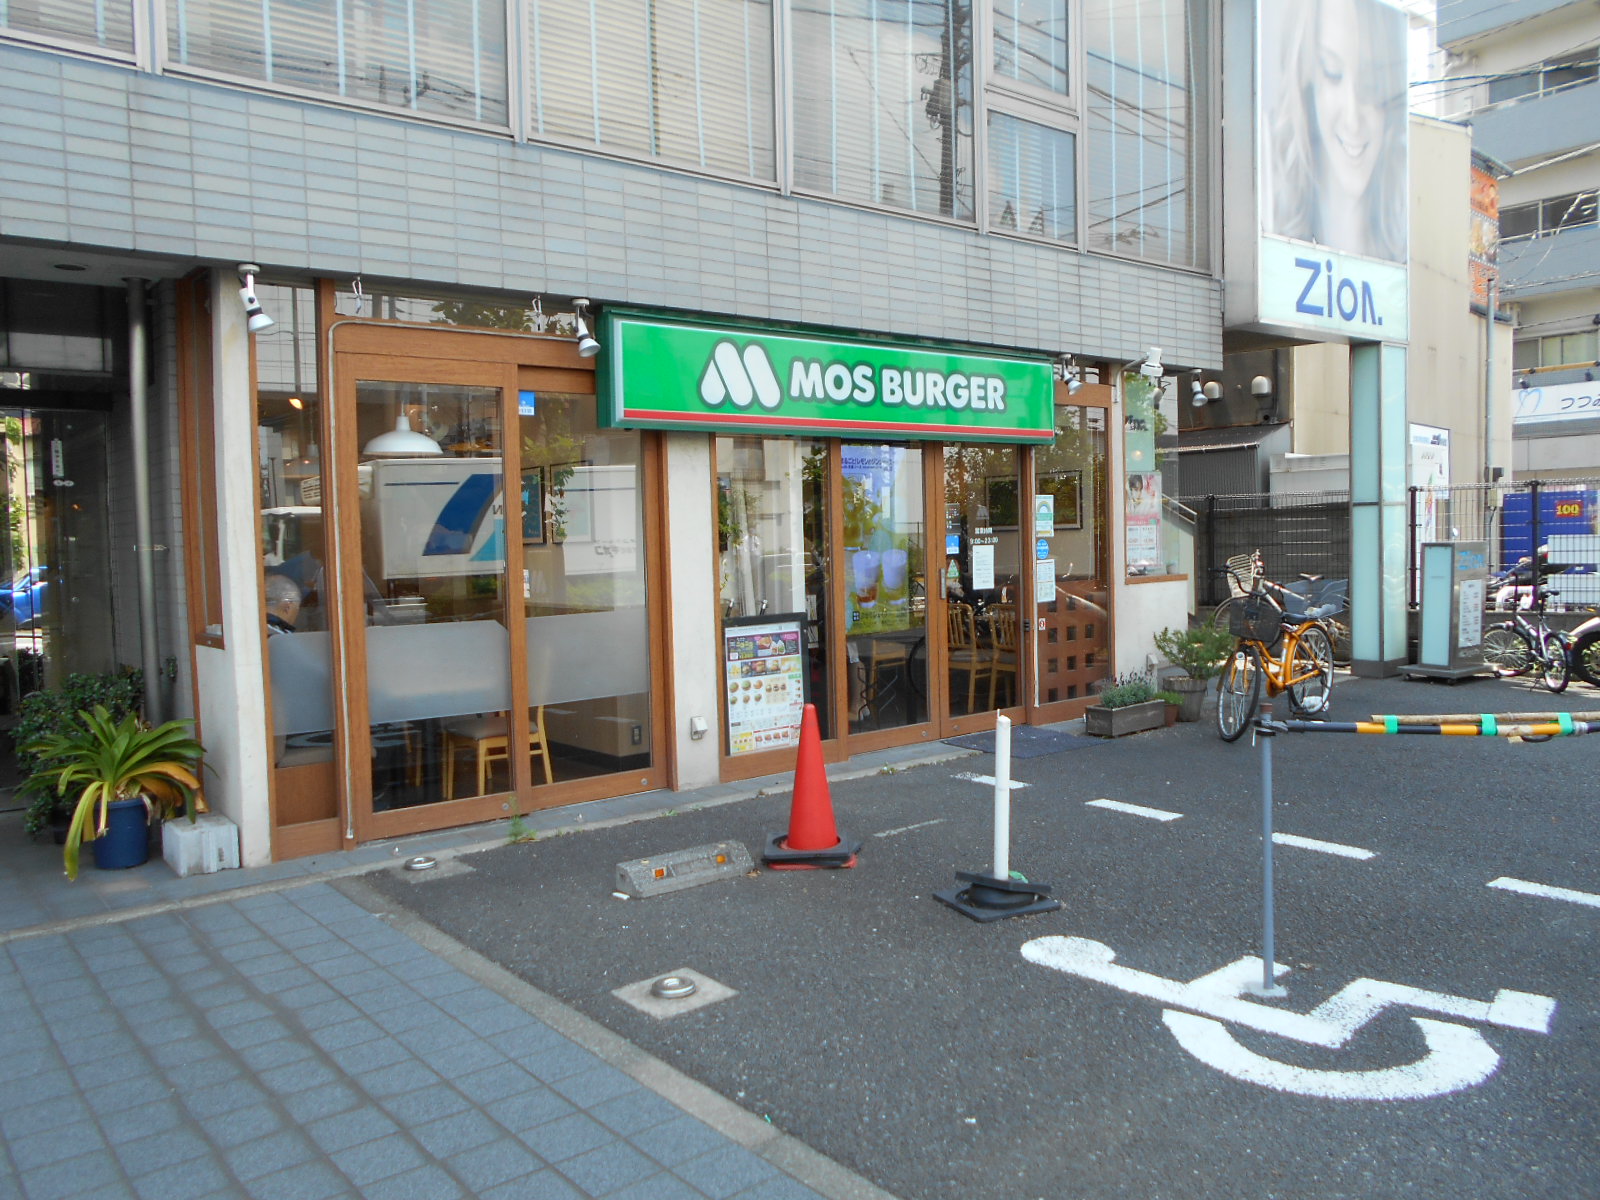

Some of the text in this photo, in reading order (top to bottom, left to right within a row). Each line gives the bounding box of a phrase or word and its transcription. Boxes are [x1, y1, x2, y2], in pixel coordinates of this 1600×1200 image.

[789, 359, 876, 403] MOS
[882, 367, 1006, 411] BURGER
[1556, 503, 1580, 515] 100
